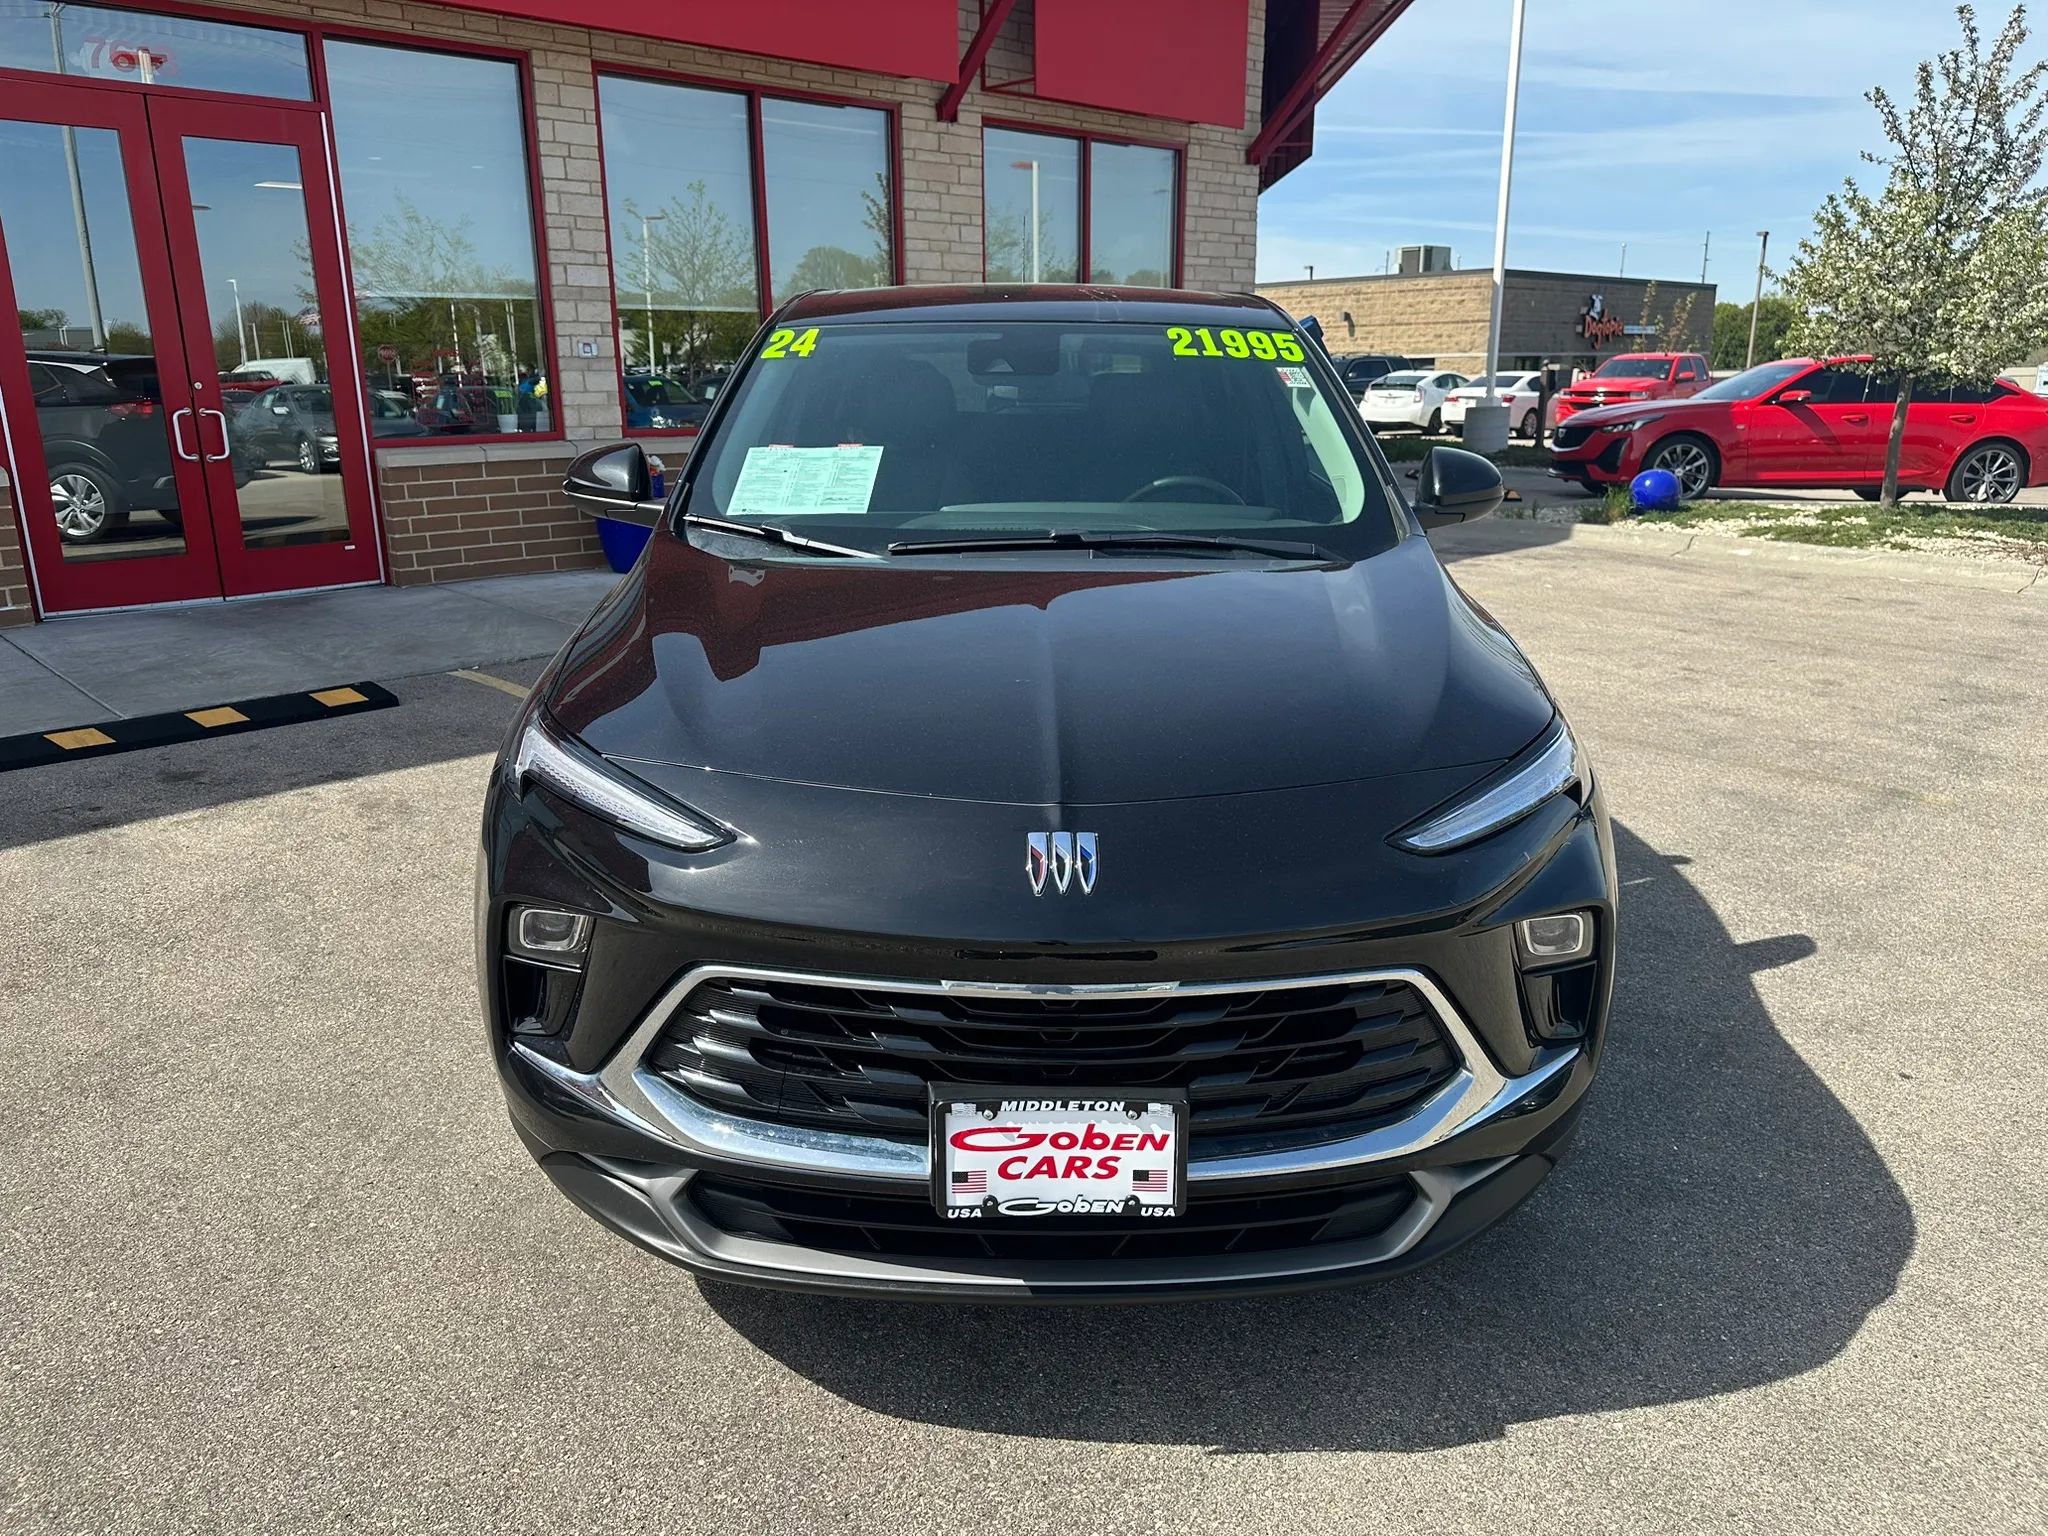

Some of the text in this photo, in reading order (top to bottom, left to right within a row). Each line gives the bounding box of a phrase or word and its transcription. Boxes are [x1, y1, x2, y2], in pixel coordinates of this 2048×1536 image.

[760, 328, 820, 359] 24
[1166, 327, 1305, 362] 21995
[1000, 1100, 1125, 1112] MIDDLETON
[997, 1155, 1123, 1180] CARS
[947, 1208, 982, 1219] USA
[1140, 1207, 1176, 1217] USA
